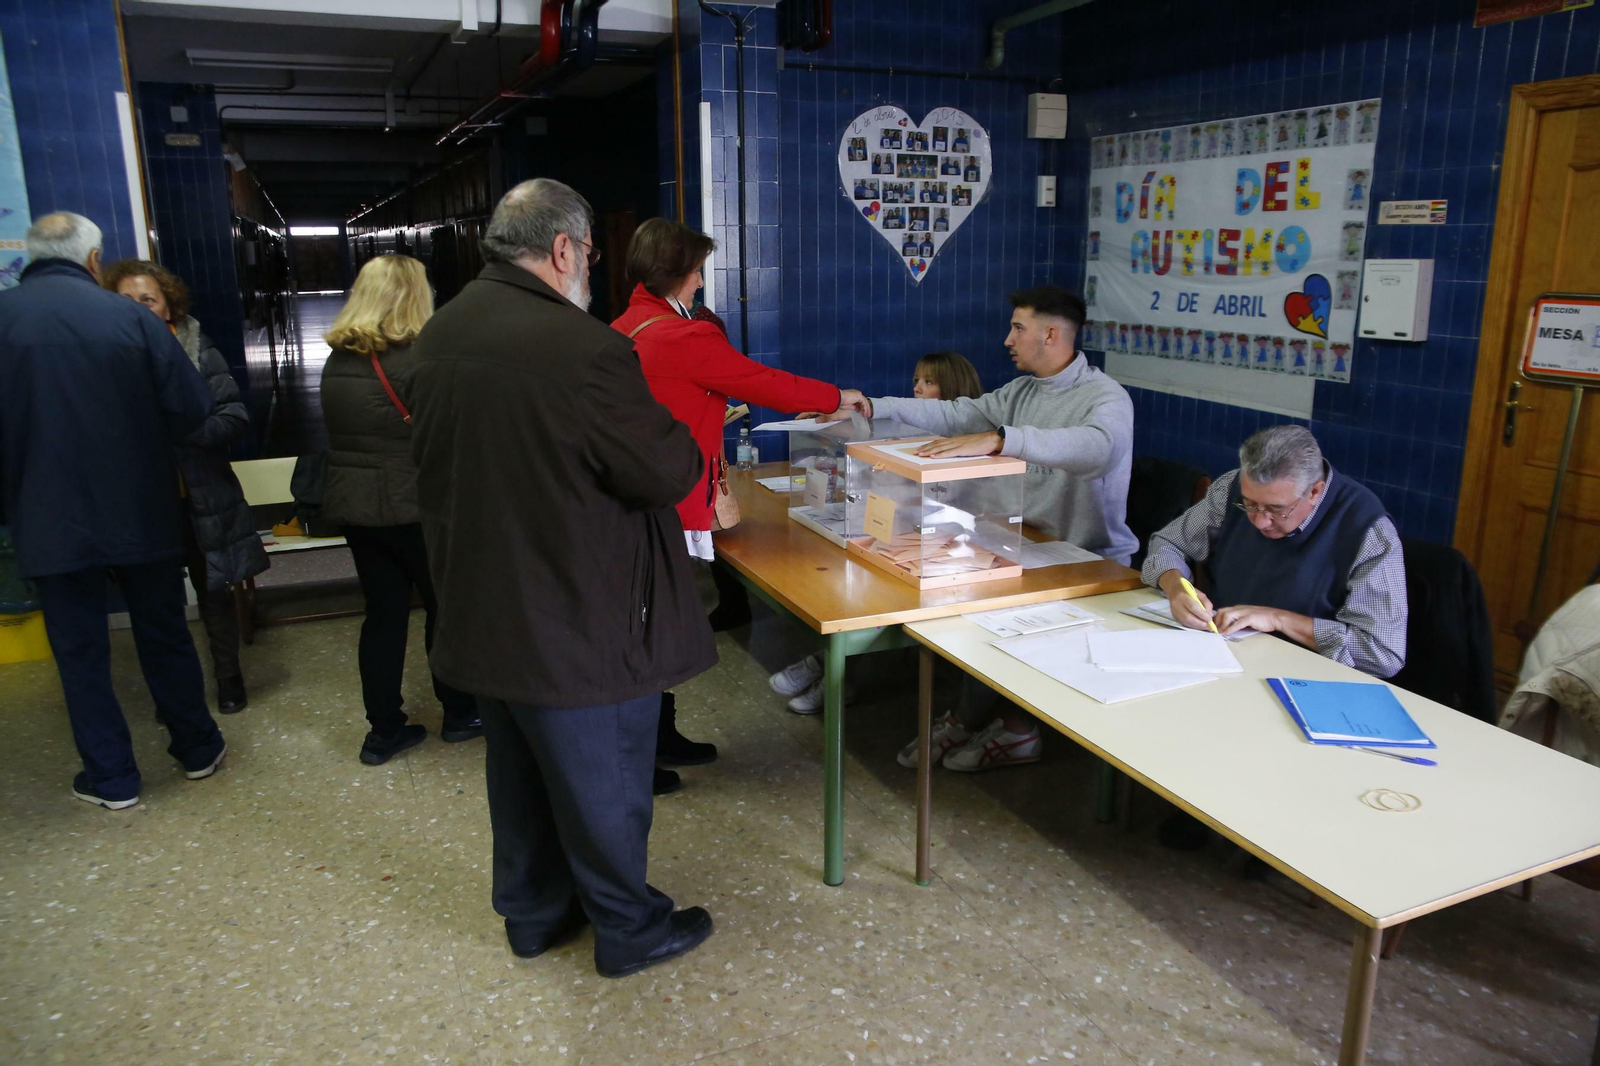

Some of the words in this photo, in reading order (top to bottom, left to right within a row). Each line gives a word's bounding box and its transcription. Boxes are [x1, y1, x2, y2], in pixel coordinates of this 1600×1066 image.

[1479, 8, 1522, 22] GROUND
[852, 121, 862, 135] 2
[863, 116, 872, 128] de
[874, 107, 897, 122] abril
[932, 108, 965, 126] 2015
[1115, 171, 1177, 224] DÍA
[1235, 157, 1321, 216] DEL
[1130, 225, 1311, 276] AUTISMO
[1150, 291, 1161, 311] 2
[1177, 292, 1200, 313] DE
[1213, 294, 1267, 317] ABRIL
[1539, 327, 1584, 341] MESA
